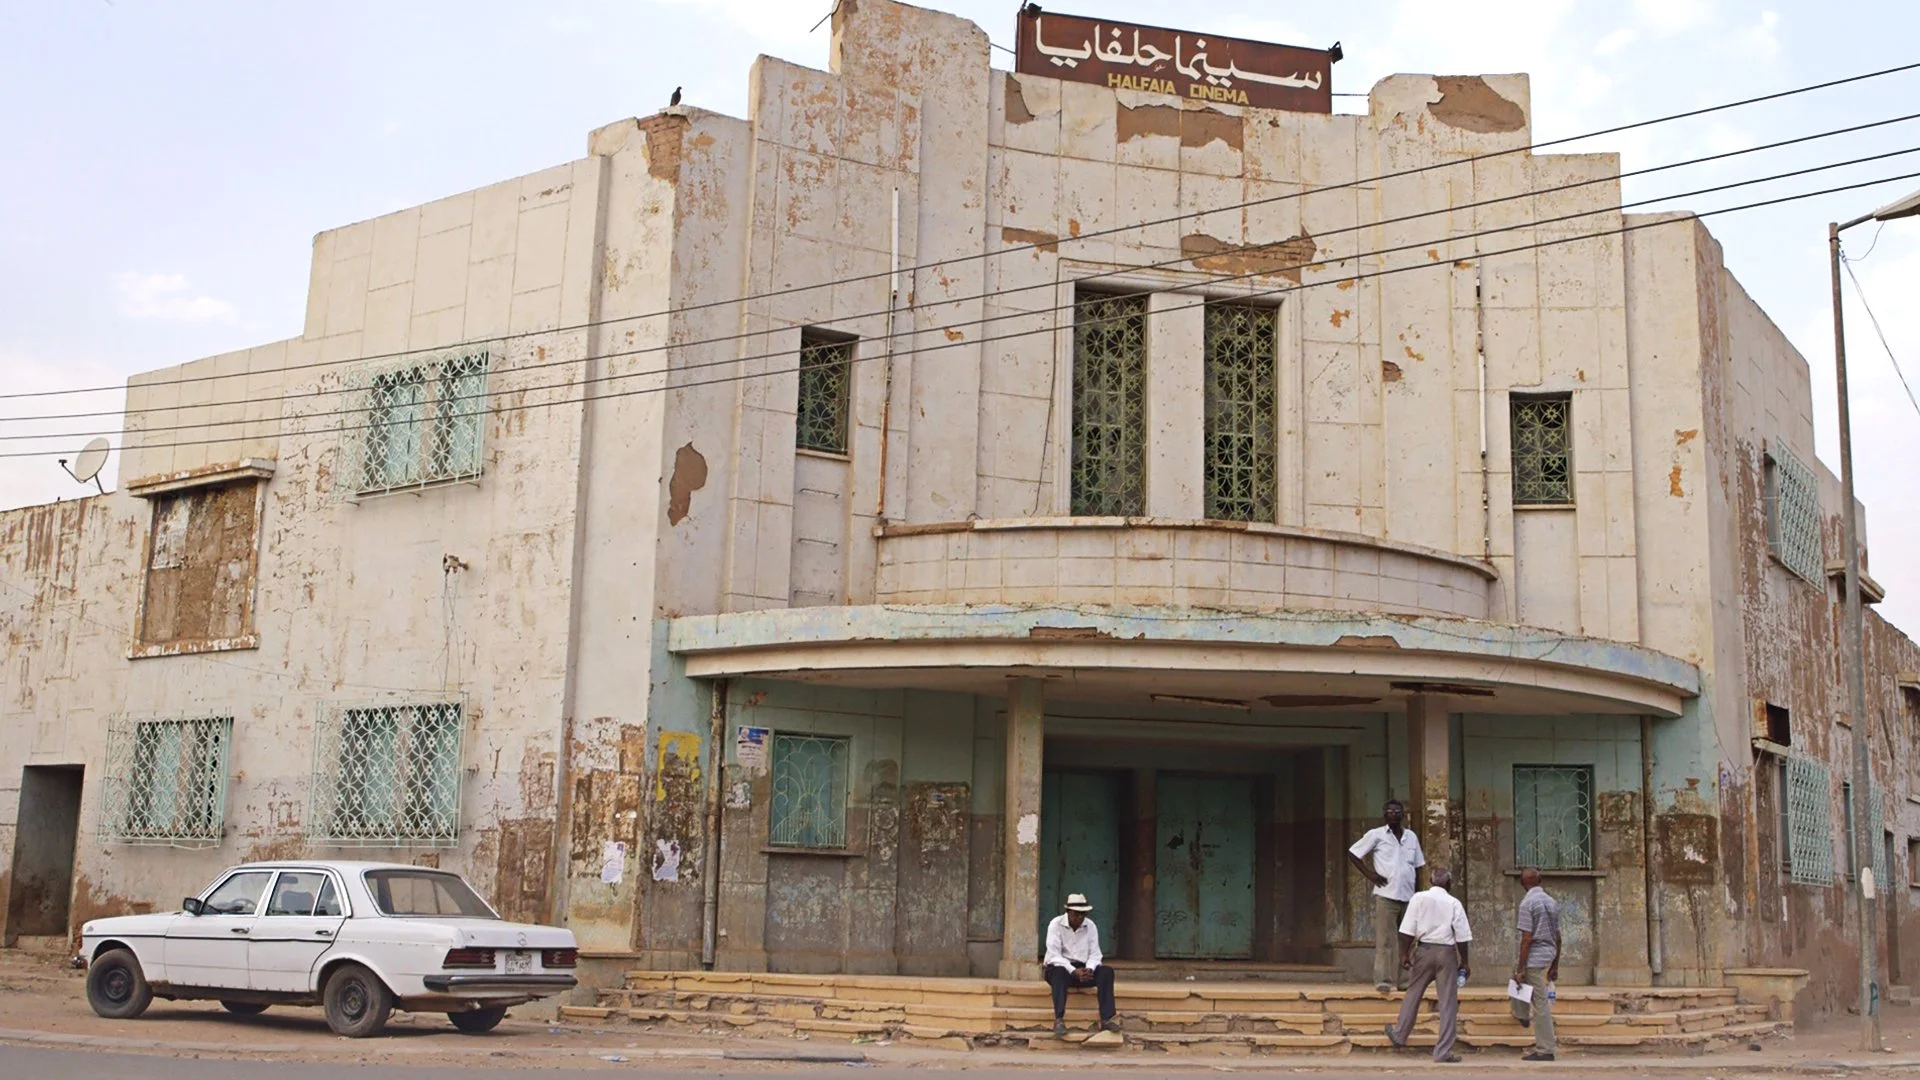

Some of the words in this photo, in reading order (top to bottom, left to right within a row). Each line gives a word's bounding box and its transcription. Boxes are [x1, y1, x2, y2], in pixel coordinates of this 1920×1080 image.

[1036, 17, 1173, 69] حلفايا
[1175, 35, 1322, 90] سينما
[1108, 73, 1176, 95] HALFAIA
[1189, 83, 1250, 105] CINEMA
